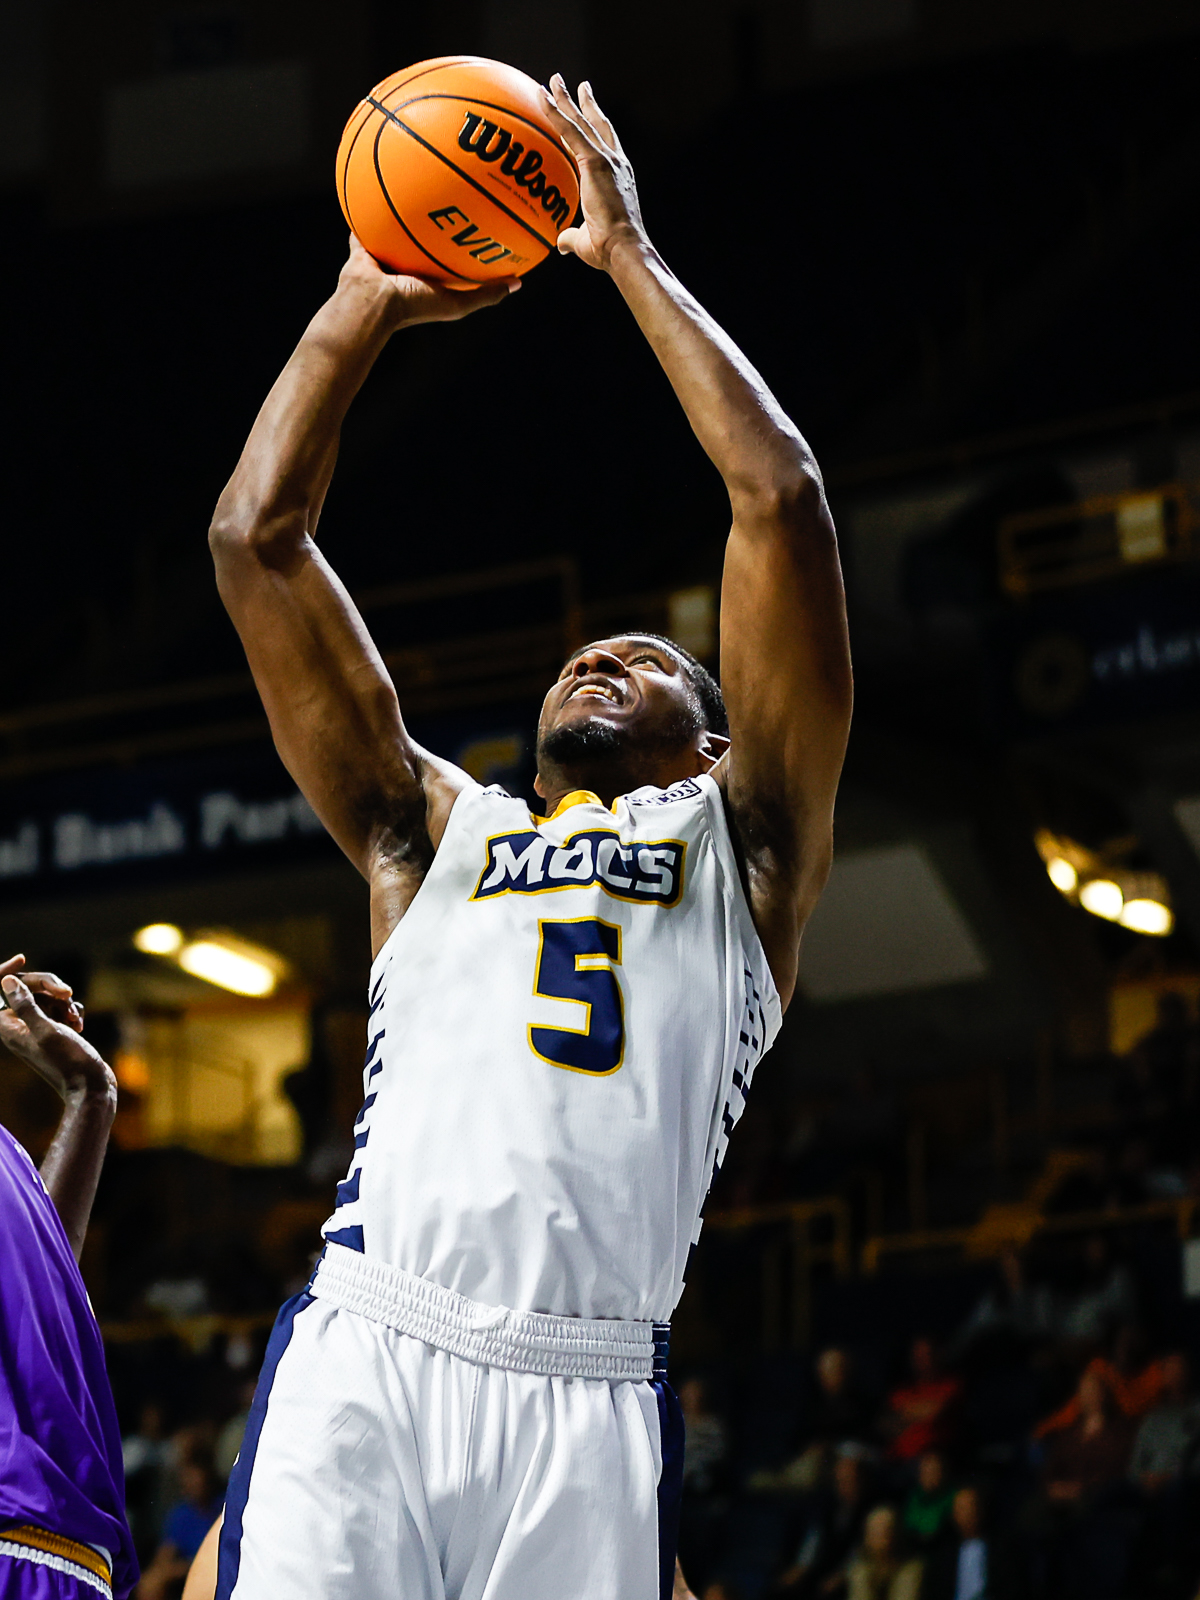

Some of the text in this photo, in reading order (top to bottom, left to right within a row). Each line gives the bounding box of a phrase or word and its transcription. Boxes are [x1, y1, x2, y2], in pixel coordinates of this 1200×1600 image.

[457, 110, 571, 231] Wilson
[480, 836, 677, 897] MOCS
[526, 915, 625, 1077] 5
